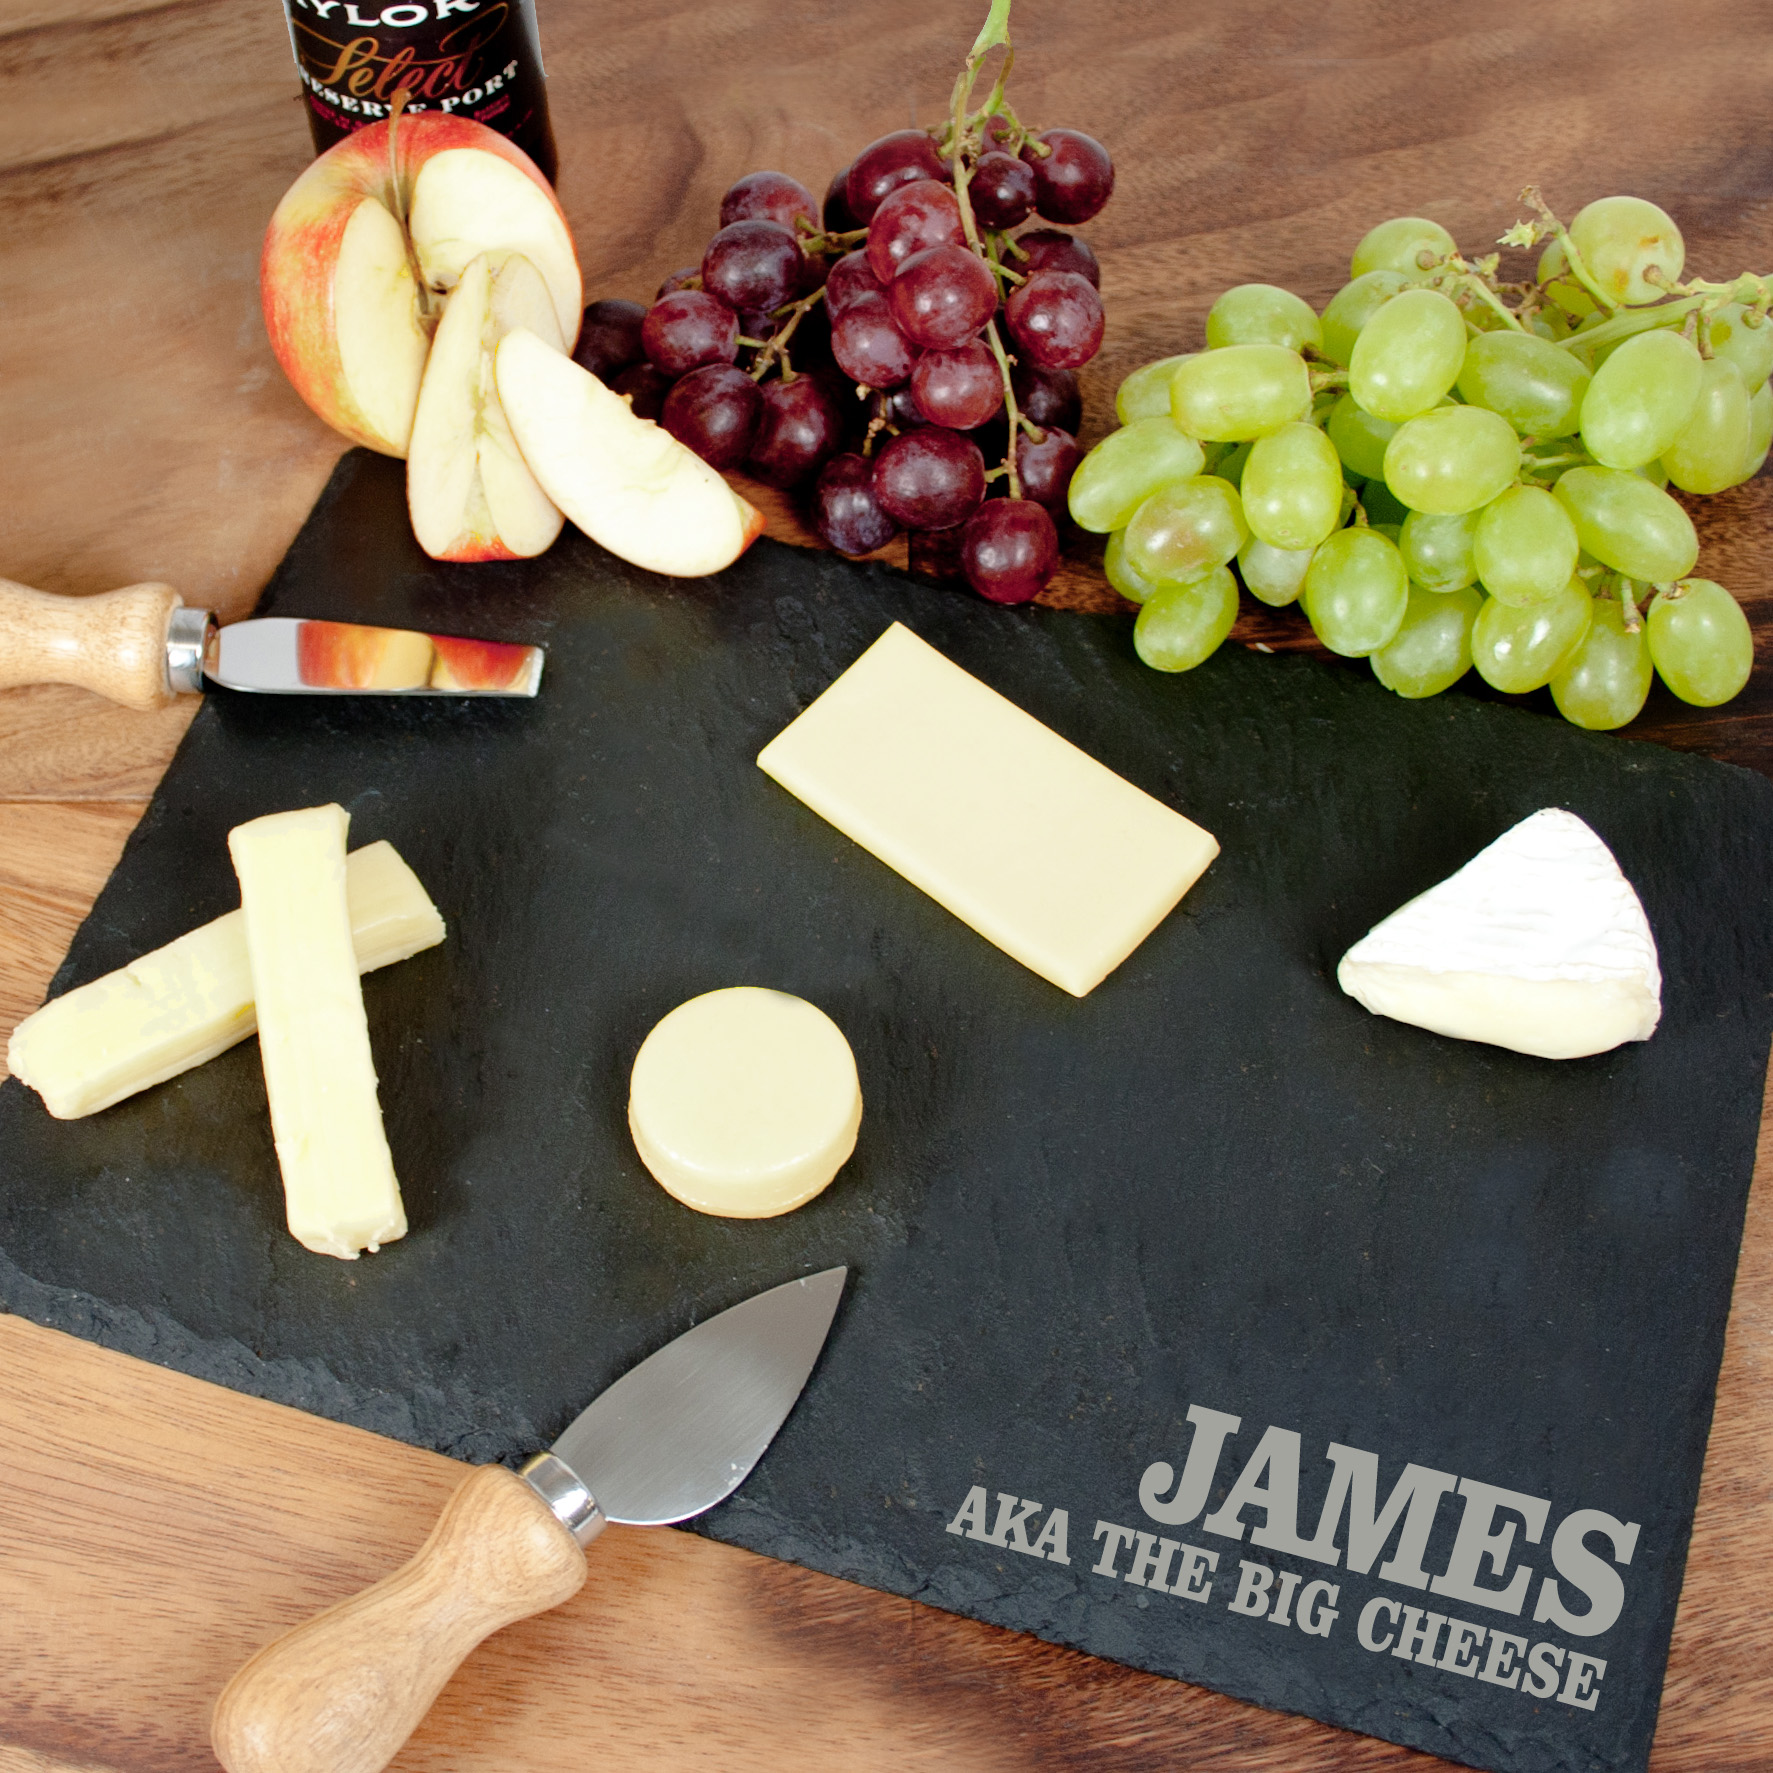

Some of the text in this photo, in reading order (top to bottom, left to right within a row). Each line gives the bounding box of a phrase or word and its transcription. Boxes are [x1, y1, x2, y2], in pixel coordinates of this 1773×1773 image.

[296, 0, 481, 28] YLOR
[310, 35, 485, 100] Select
[440, 59, 518, 114] PORT
[1139, 1404, 1641, 1637] JAMES
[946, 1485, 1608, 1712] AKA THE BIG CHEESE
